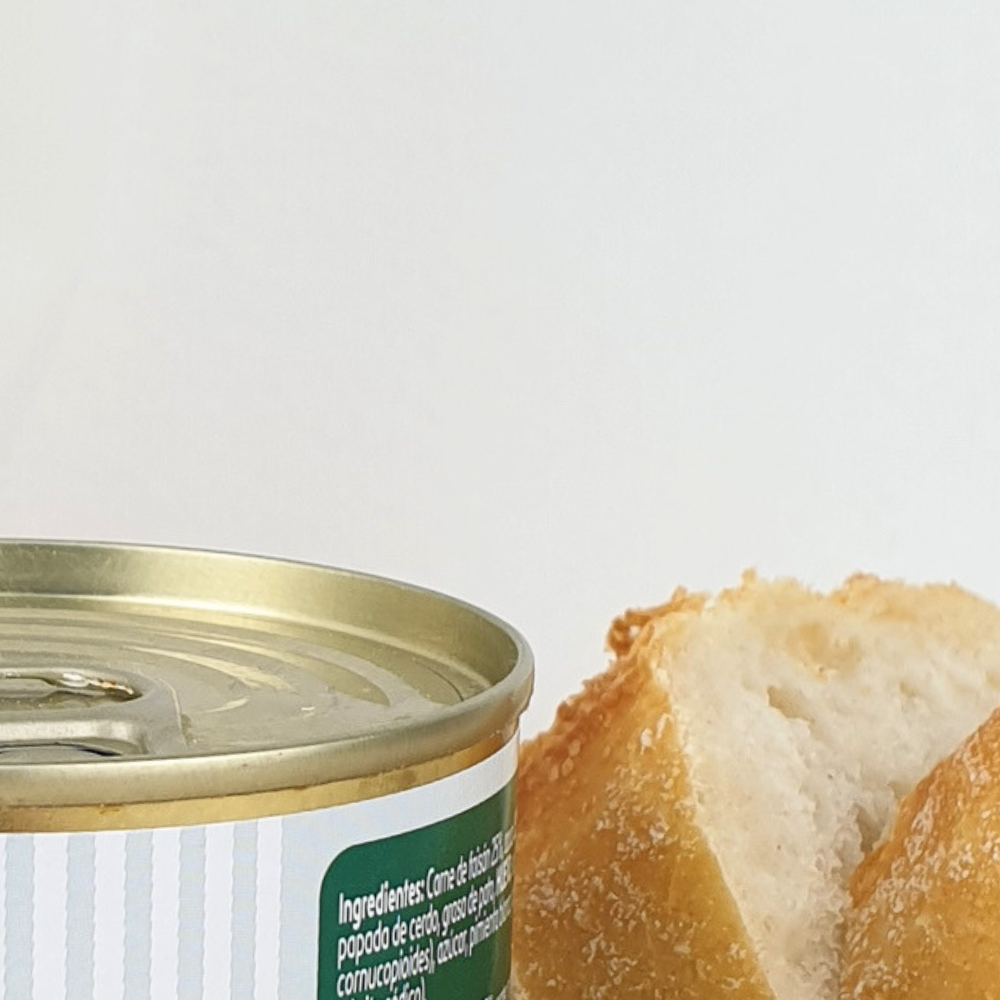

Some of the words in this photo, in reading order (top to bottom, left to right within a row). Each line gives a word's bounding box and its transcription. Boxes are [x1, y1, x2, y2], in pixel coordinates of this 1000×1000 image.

[337, 920, 388, 969] papada
[392, 915, 407, 946] de
[409, 904, 441, 940] cerdo,
[441, 895, 467, 936] grasa
[467, 885, 477, 915] de
[339, 879, 425, 930] Ingredientes:
[457, 855, 468, 886] de
